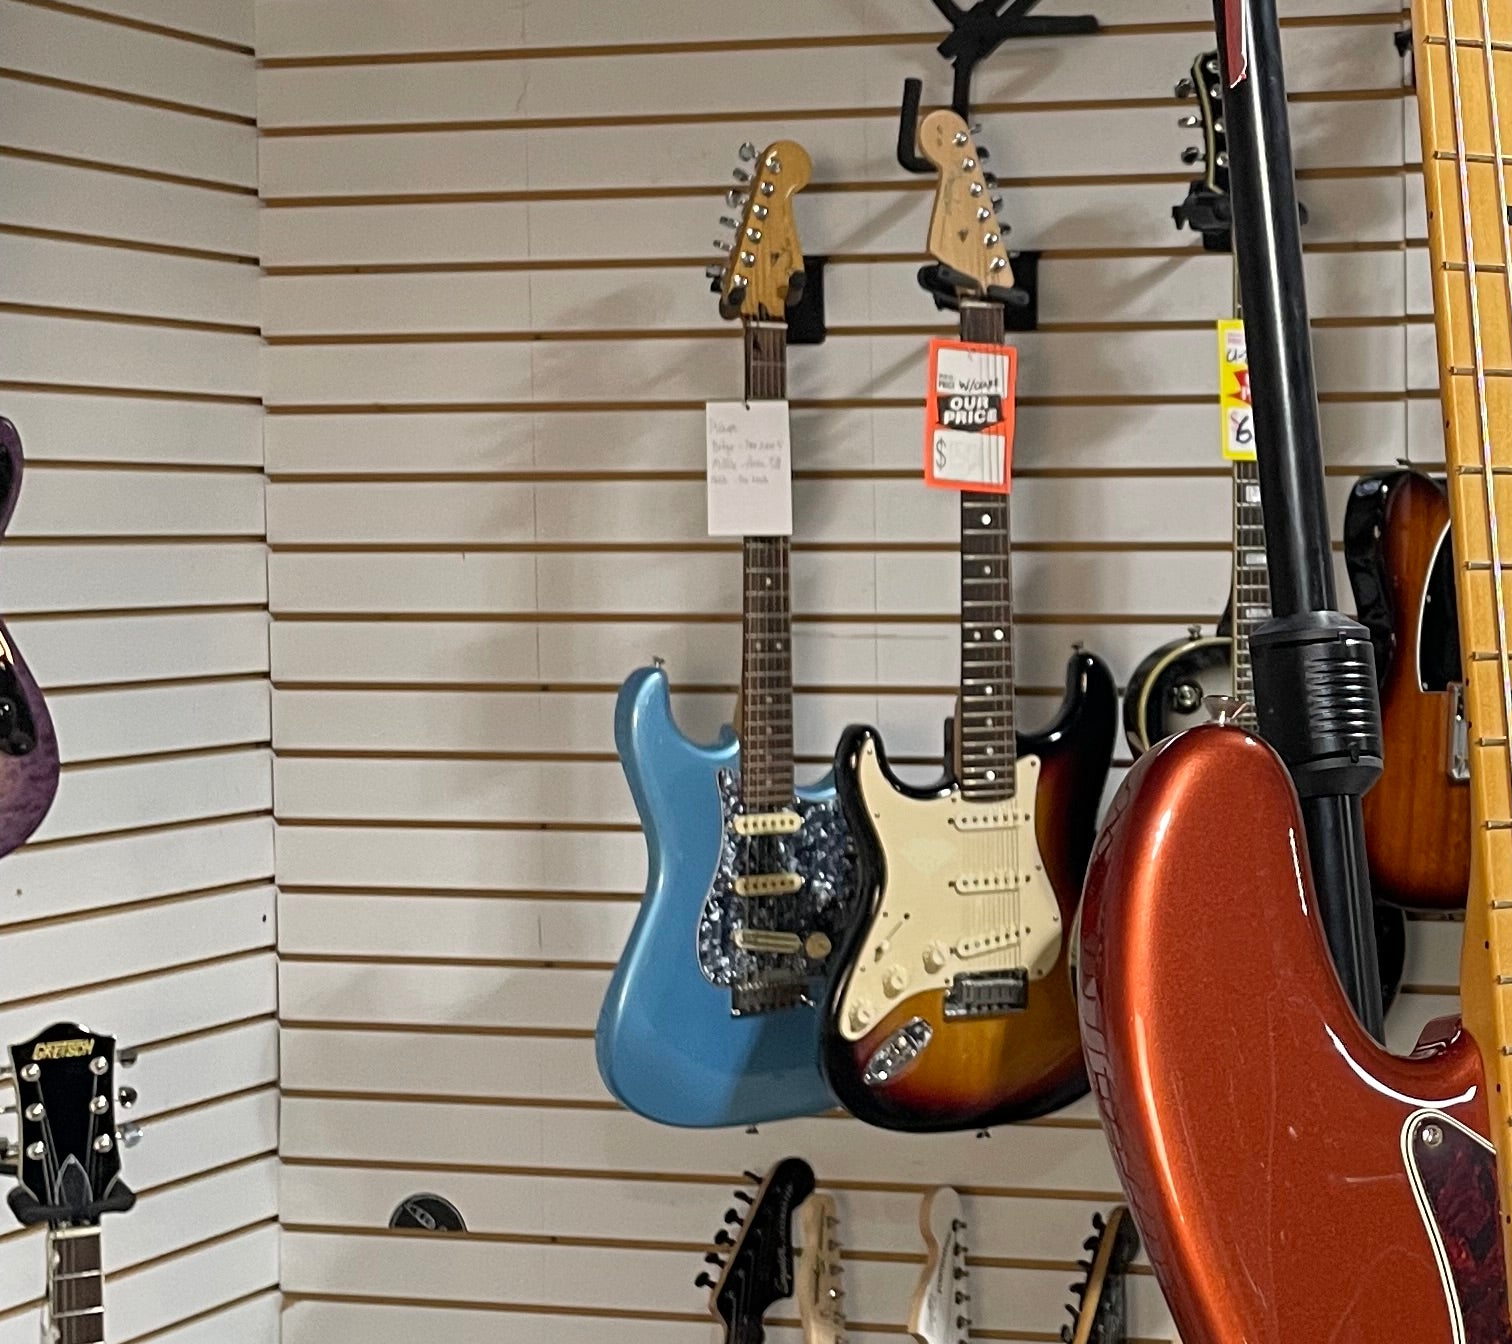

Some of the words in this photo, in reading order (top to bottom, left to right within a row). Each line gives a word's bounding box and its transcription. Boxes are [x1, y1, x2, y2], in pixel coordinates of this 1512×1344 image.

[950, 396, 990, 411] OUR
[943, 408, 998, 426] PRICE
[935, 437, 947, 471] $
